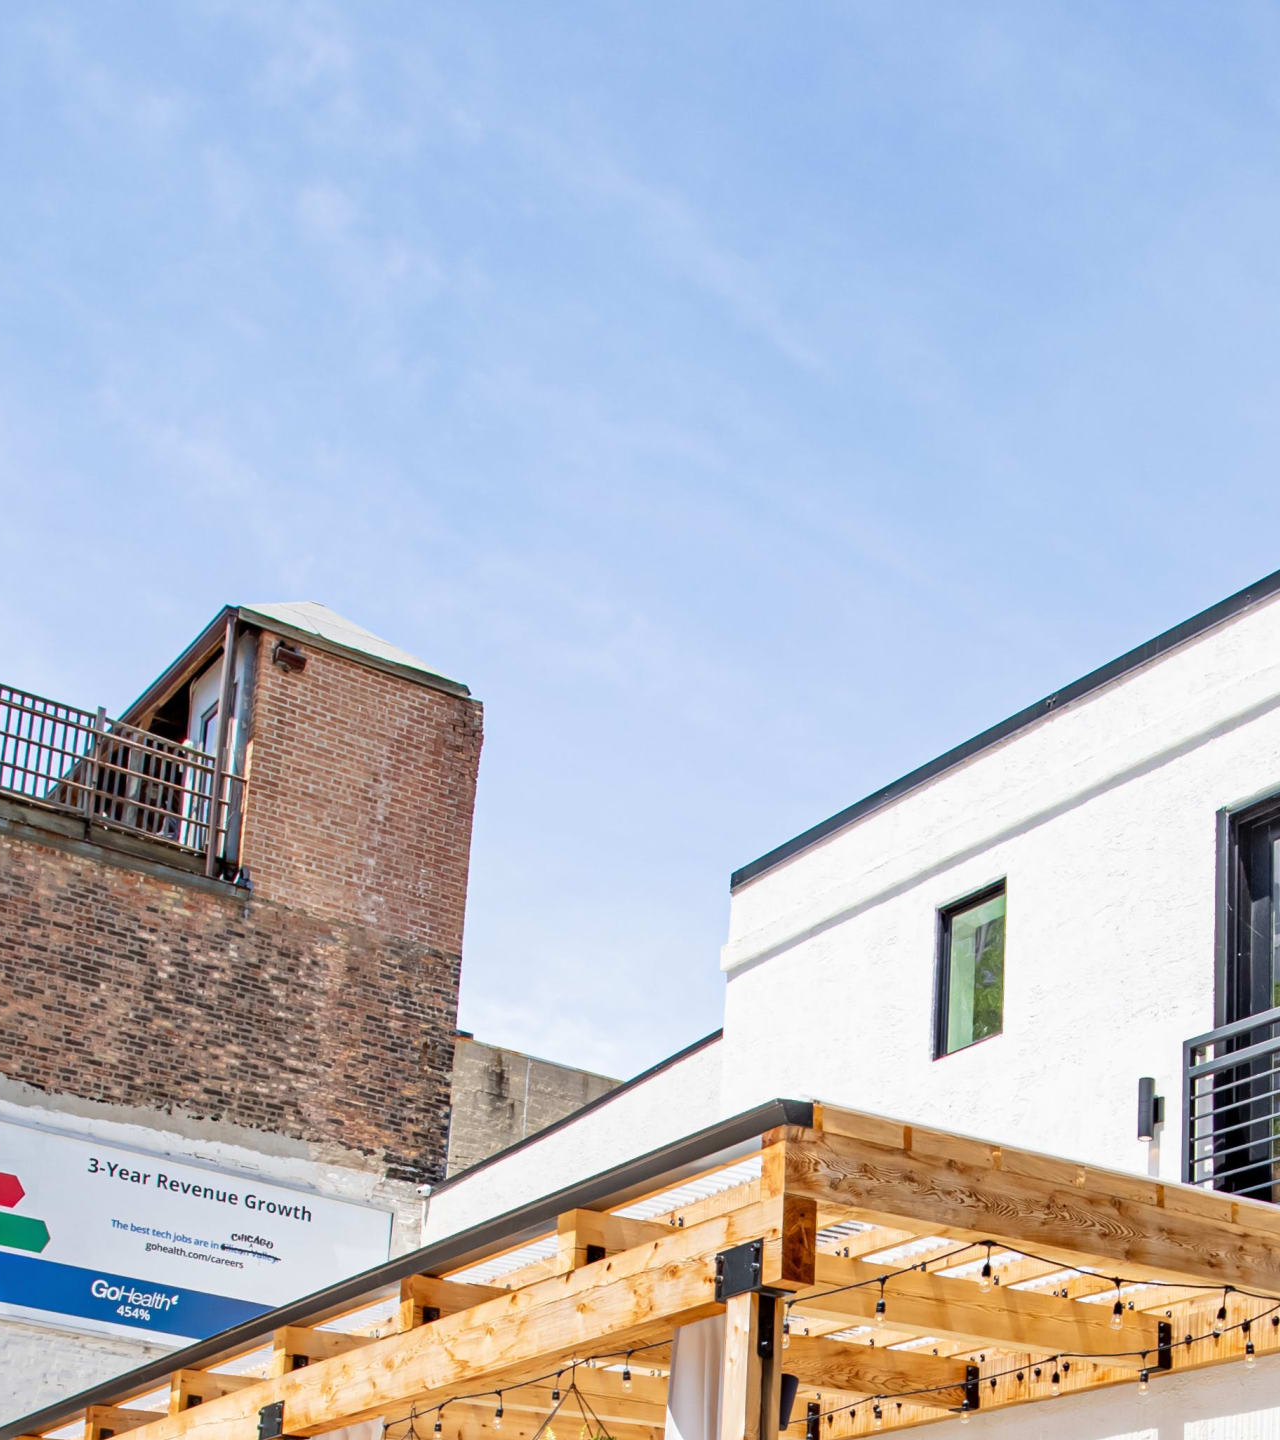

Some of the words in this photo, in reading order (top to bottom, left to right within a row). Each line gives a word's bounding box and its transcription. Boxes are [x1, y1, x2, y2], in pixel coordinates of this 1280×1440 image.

[87, 1157, 151, 1185] 3-Year
[156, 1173, 239, 1206] Revenue
[244, 1194, 312, 1223] Growth
[111, 1219, 129, 1231] The
[130, 1222, 150, 1236] best
[152, 1226, 172, 1240] tech
[172, 1231, 192, 1245] jobs
[193, 1237, 209, 1249] are
[210, 1239, 220, 1250] in
[144, 1240, 244, 1269] gohealth.com/careers
[90, 1279, 171, 1311] GoHealth
[116, 1305, 151, 1321] 454%
